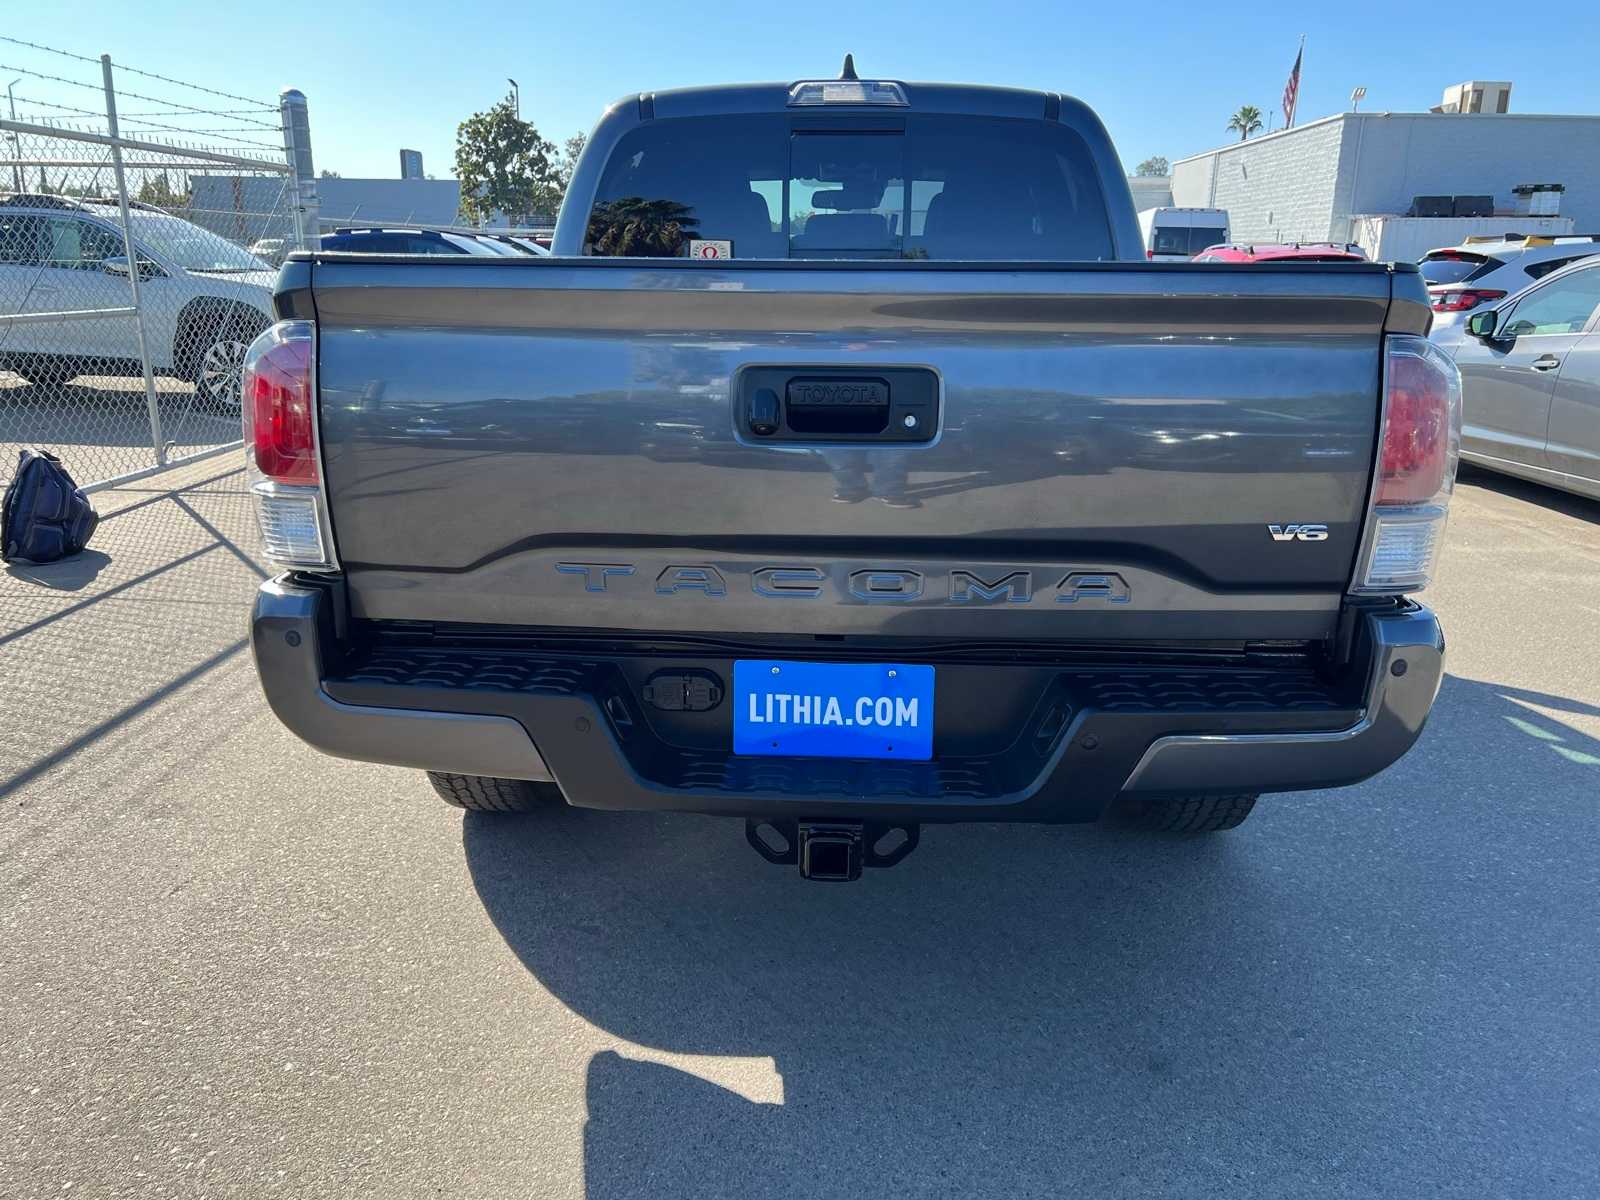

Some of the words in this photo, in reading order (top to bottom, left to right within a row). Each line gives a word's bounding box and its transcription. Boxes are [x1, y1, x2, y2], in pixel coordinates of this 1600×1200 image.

[798, 384, 881, 404] TOYOTA
[1267, 524, 1329, 541] V6
[555, 561, 1131, 604] TACOMA
[749, 693, 919, 727] LITHIA.COM
